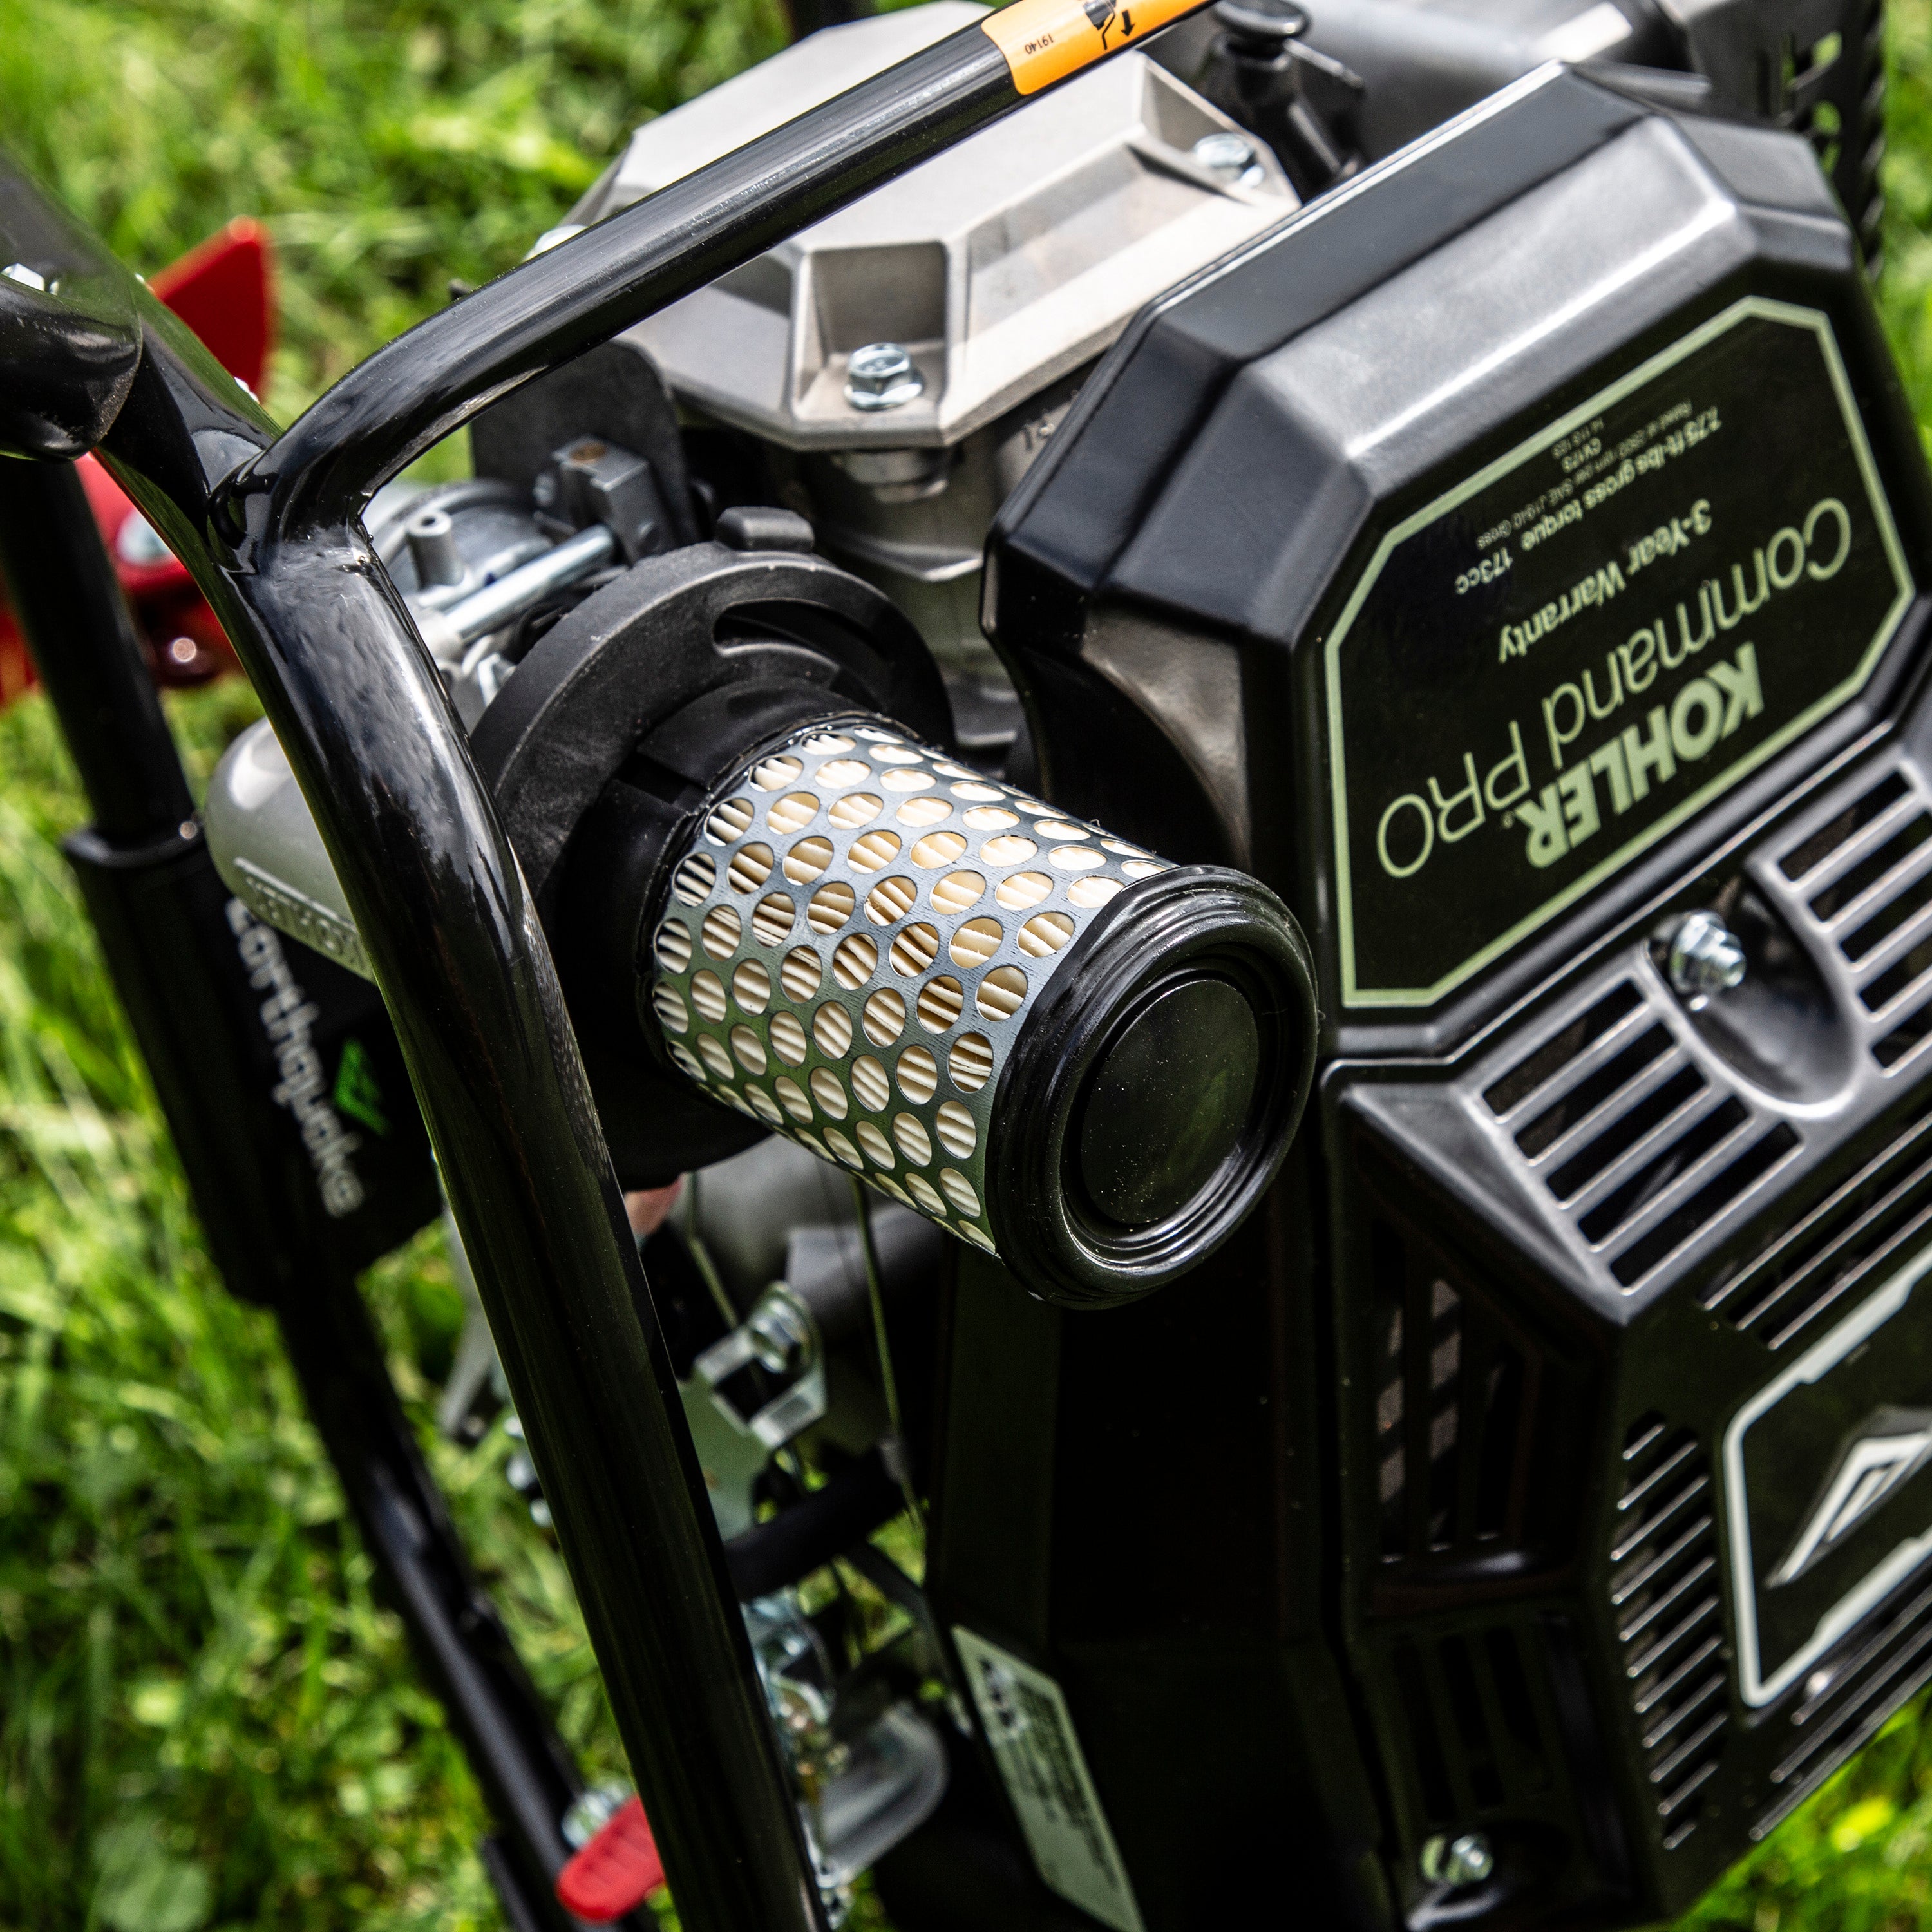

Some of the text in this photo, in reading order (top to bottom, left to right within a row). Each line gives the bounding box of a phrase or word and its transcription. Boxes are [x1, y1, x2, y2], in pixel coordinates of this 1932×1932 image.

[1025, 33, 1054, 55] 19140
[1634, 430, 1686, 475] ft-lbs
[1582, 458, 1636, 510] gross
[1476, 518, 1513, 551] Gross
[1520, 498, 1584, 551] torque
[1454, 546, 1513, 596] 173cc
[1497, 498, 1713, 664] 3-Year Warranty
[1377, 498, 1851, 878] Command PRO
[1515, 642, 1764, 869] KOHLER
